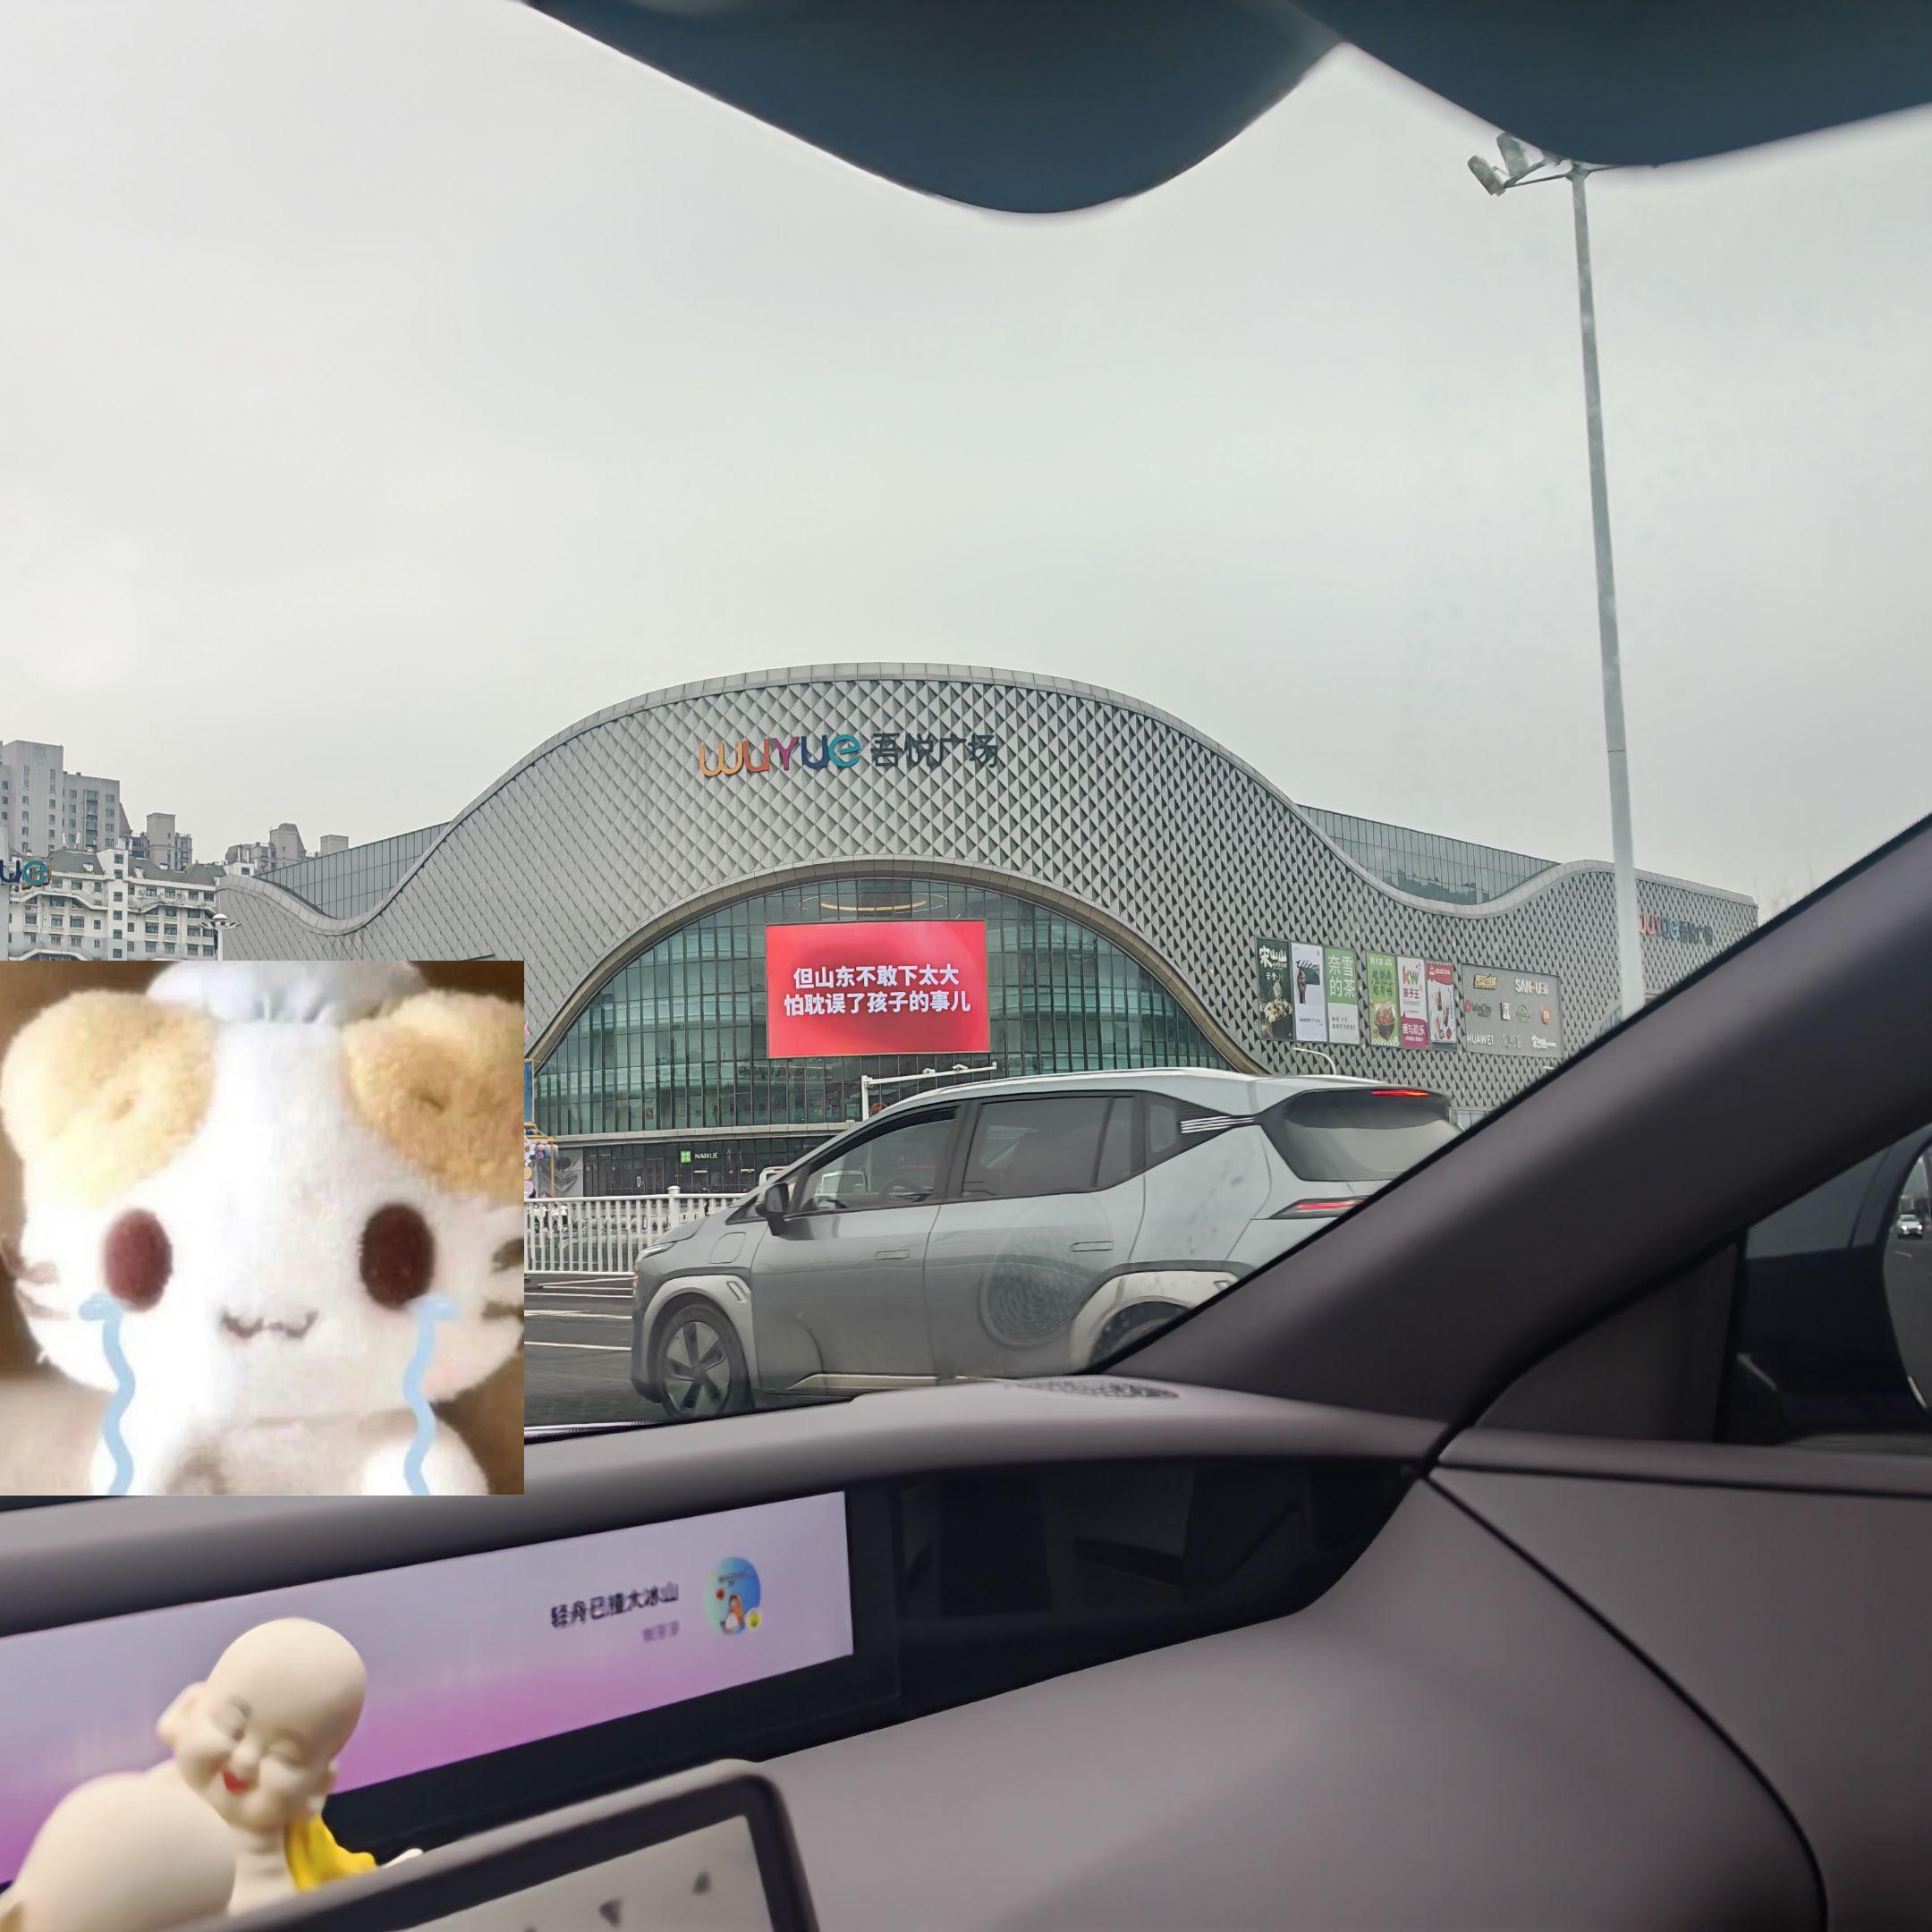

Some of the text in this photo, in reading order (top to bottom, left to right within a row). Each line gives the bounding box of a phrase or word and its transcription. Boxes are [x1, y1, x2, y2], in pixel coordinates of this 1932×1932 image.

[871, 733, 998, 768] 吾悦广场
[793, 963, 960, 990] 但山东不敢下太大
[784, 990, 971, 1017] 怕耽误了孩子的事儿
[1467, 1034, 1495, 1046] HUAWEI
